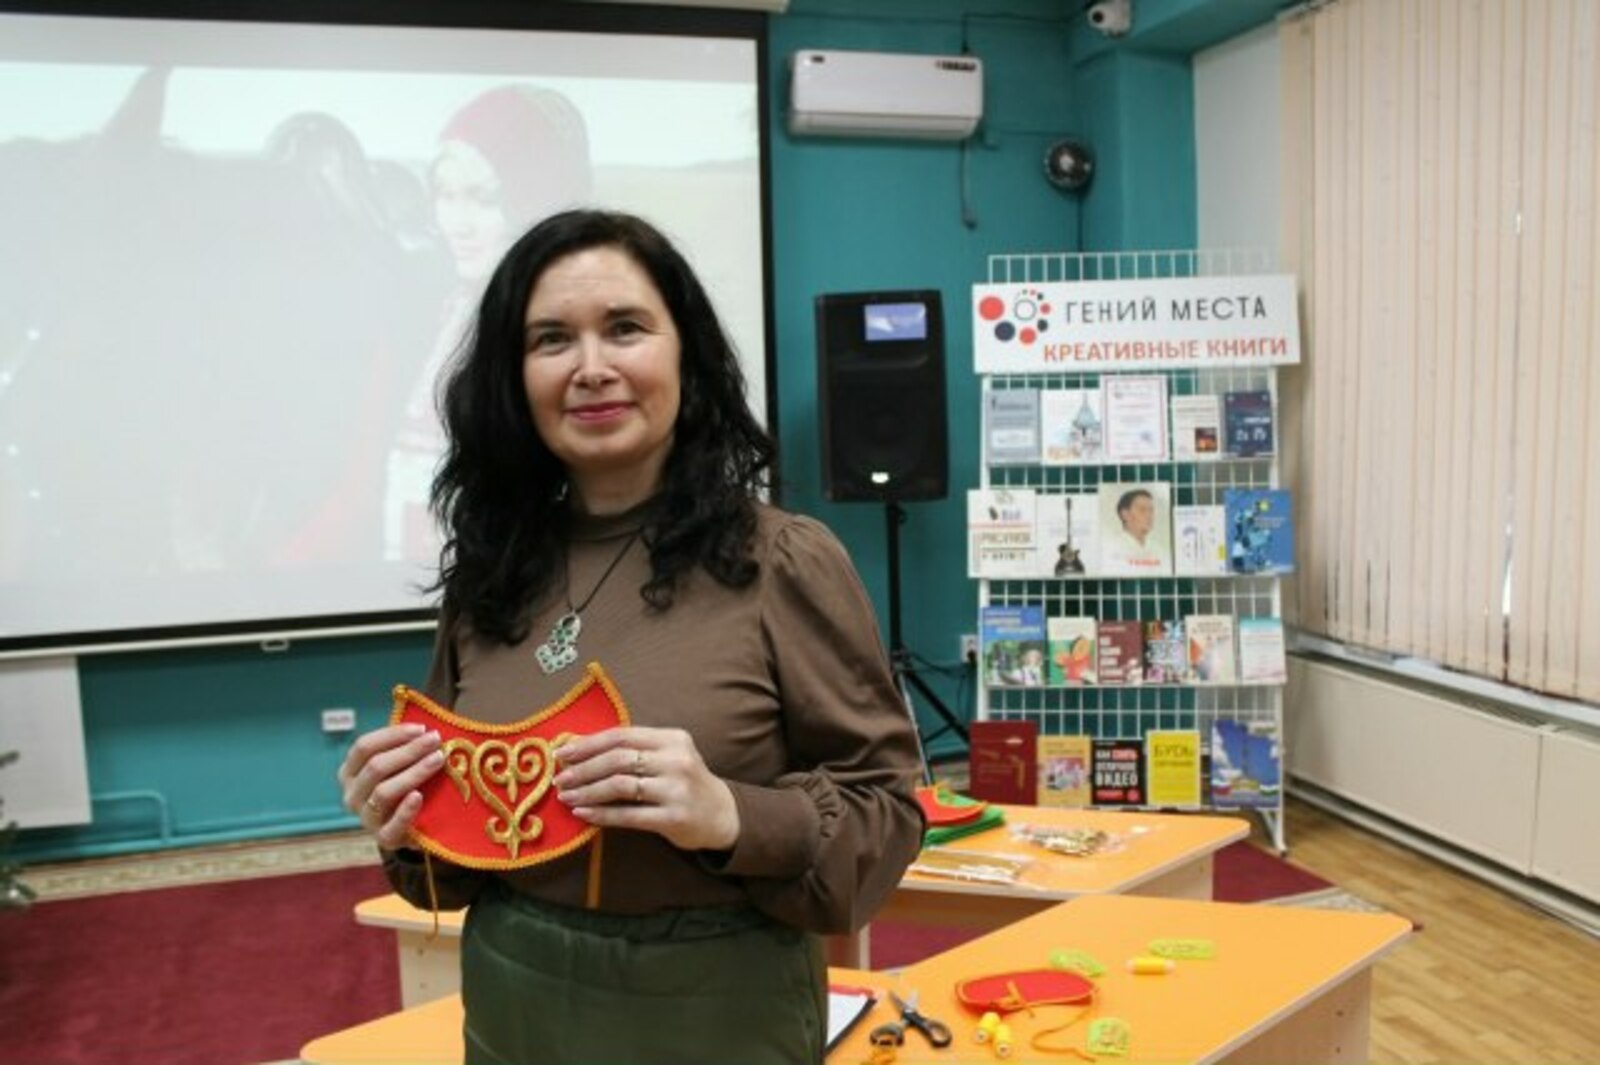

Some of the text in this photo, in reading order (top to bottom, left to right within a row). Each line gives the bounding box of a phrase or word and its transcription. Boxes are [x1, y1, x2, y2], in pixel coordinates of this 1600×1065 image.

[1066, 296, 1267, 323] ГЕНИЙ МЕСТА
[1043, 337, 1288, 362] КРЕАТИВНЫЕ КНИГИ
[1095, 771, 1139, 787] ВИДЕО
